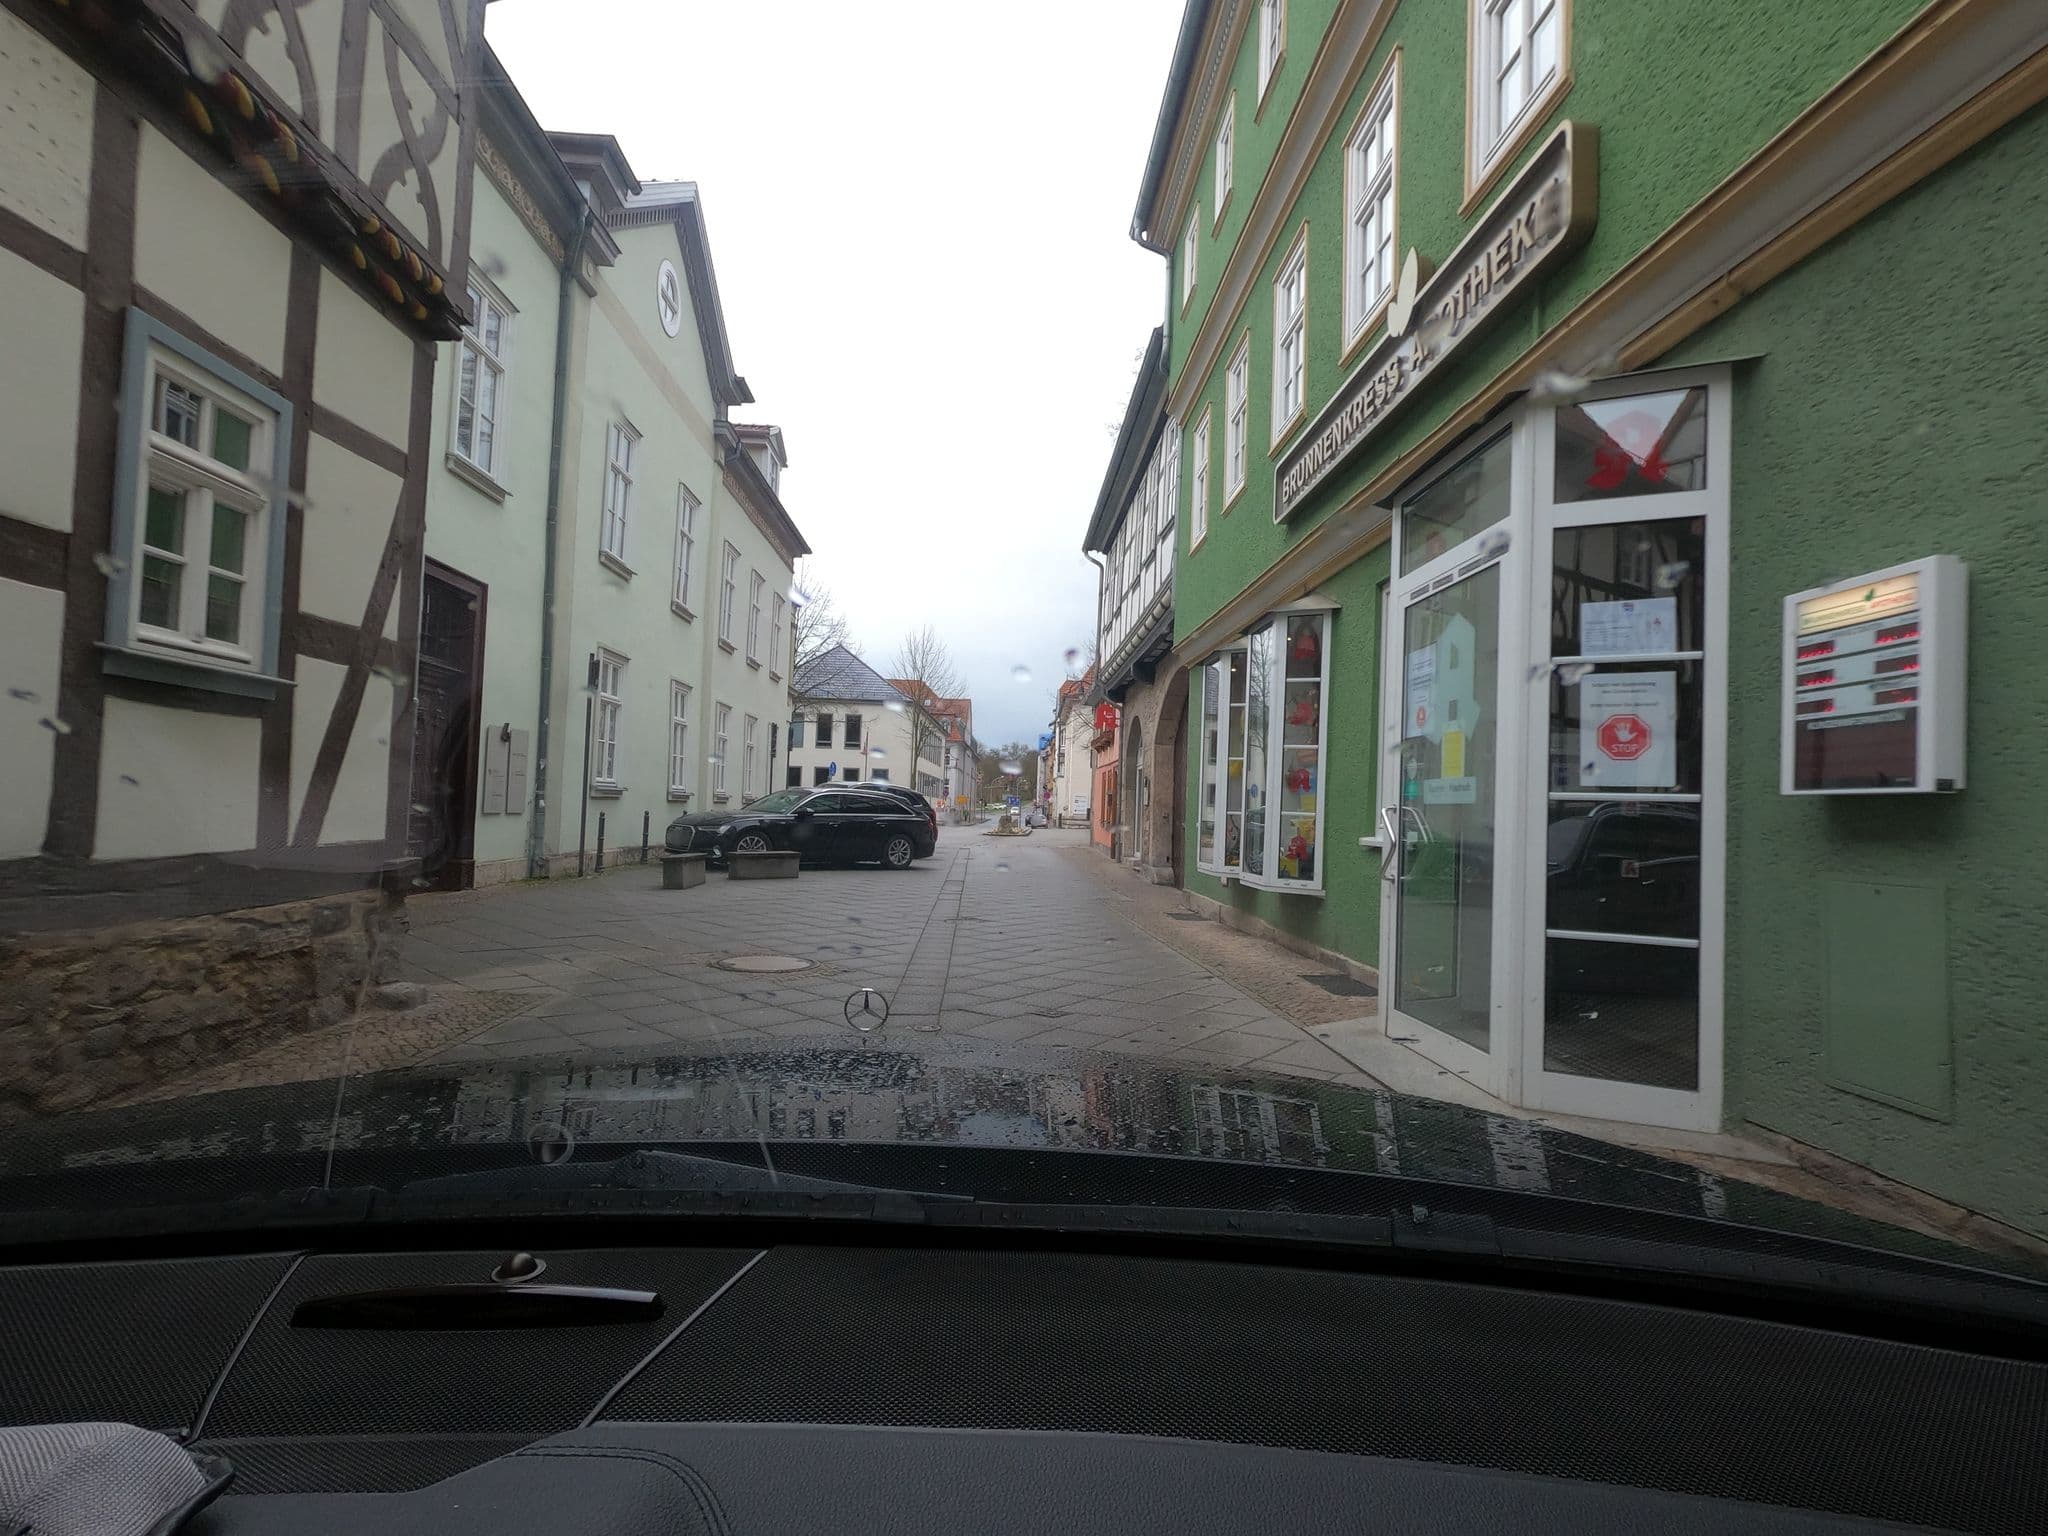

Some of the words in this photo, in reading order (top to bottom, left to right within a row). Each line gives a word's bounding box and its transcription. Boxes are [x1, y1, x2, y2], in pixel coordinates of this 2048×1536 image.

[1282, 354, 1401, 504] BRUNNENKRESS
[1410, 173, 1565, 373] AOTHEK
[1611, 743, 1640, 753] STOP
